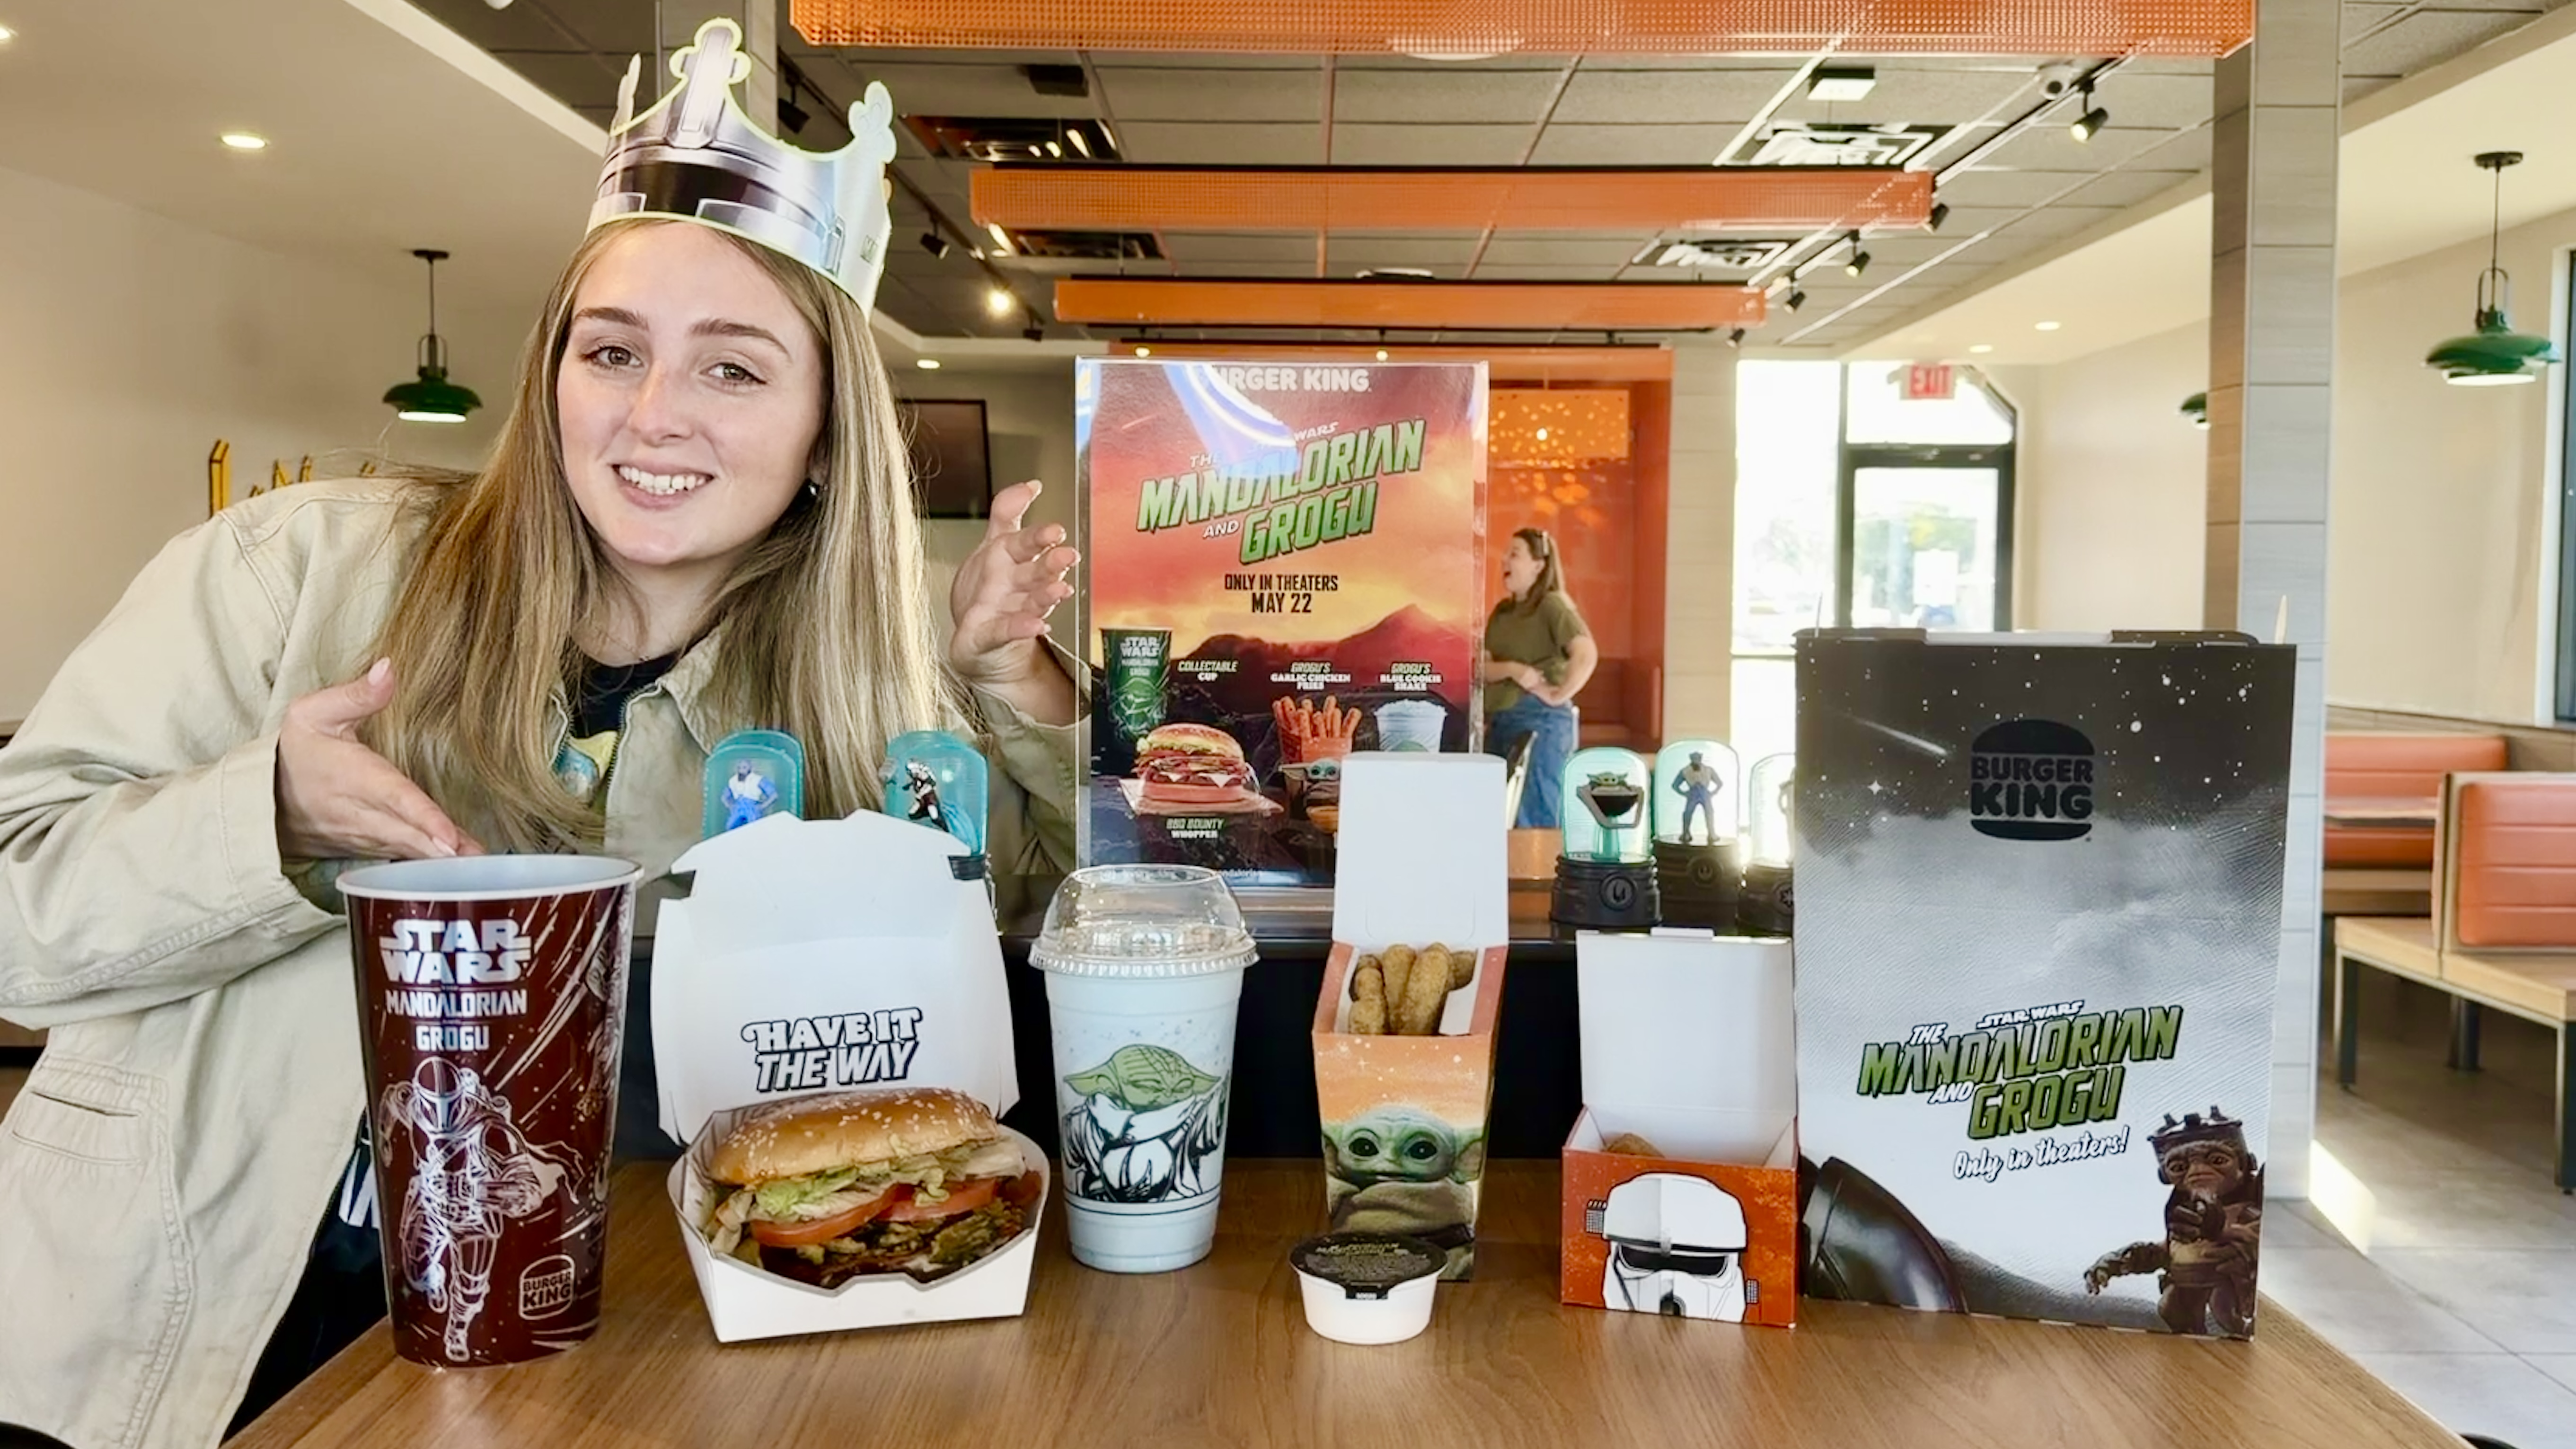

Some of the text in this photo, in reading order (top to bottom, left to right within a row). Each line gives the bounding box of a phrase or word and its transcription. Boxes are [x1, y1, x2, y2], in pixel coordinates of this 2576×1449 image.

[1909, 364, 1950, 397] EXIT
[1294, 421, 1339, 442] WARS
[1136, 419, 1426, 534] MANDALORIAN
[1202, 481, 1378, 564] AND GROGU
[1224, 574, 1339, 592] ONLY IN THEATERS
[1252, 592, 1312, 613] MAY 22
[1120, 647, 1160, 657] WARS
[1121, 636, 1160, 648] STAR
[1177, 660, 1239, 672] COLLECTABLE
[1197, 672, 1218, 681] CUP
[1270, 672, 1352, 683] GARLIC CHICKEN
[1290, 662, 1332, 673] GROGU'S
[1379, 673, 1442, 683] BLUE COOKIE
[1391, 663, 1432, 674] GROGU'S
[1296, 681, 1325, 690] FRIES
[1394, 682, 1427, 691] SHAKE
[1971, 757, 2093, 784] BURGER
[1971, 782, 2093, 820] KING
[1165, 818, 1225, 830] BBQ BOUNTY
[1170, 830, 1218, 839] WHOPPER
[379, 919, 531, 951] STAR
[379, 949, 531, 985] WARS
[386, 989, 527, 1017] MANDALORIAN
[1976, 999, 2084, 1030] STAR WARS
[416, 1025, 489, 1051] GROGU
[741, 1007, 923, 1054] HAVE IT
[1909, 1022, 1948, 1046] THE
[1857, 1006, 2183, 1098] MANDALORIAN
[755, 1041, 919, 1093] THE WAY
[1928, 1065, 2126, 1140] AND GROGU
[1953, 1124, 2130, 1183] Only in theaters!
[523, 1272, 571, 1292] BURGER
[523, 1283, 571, 1308] KING
